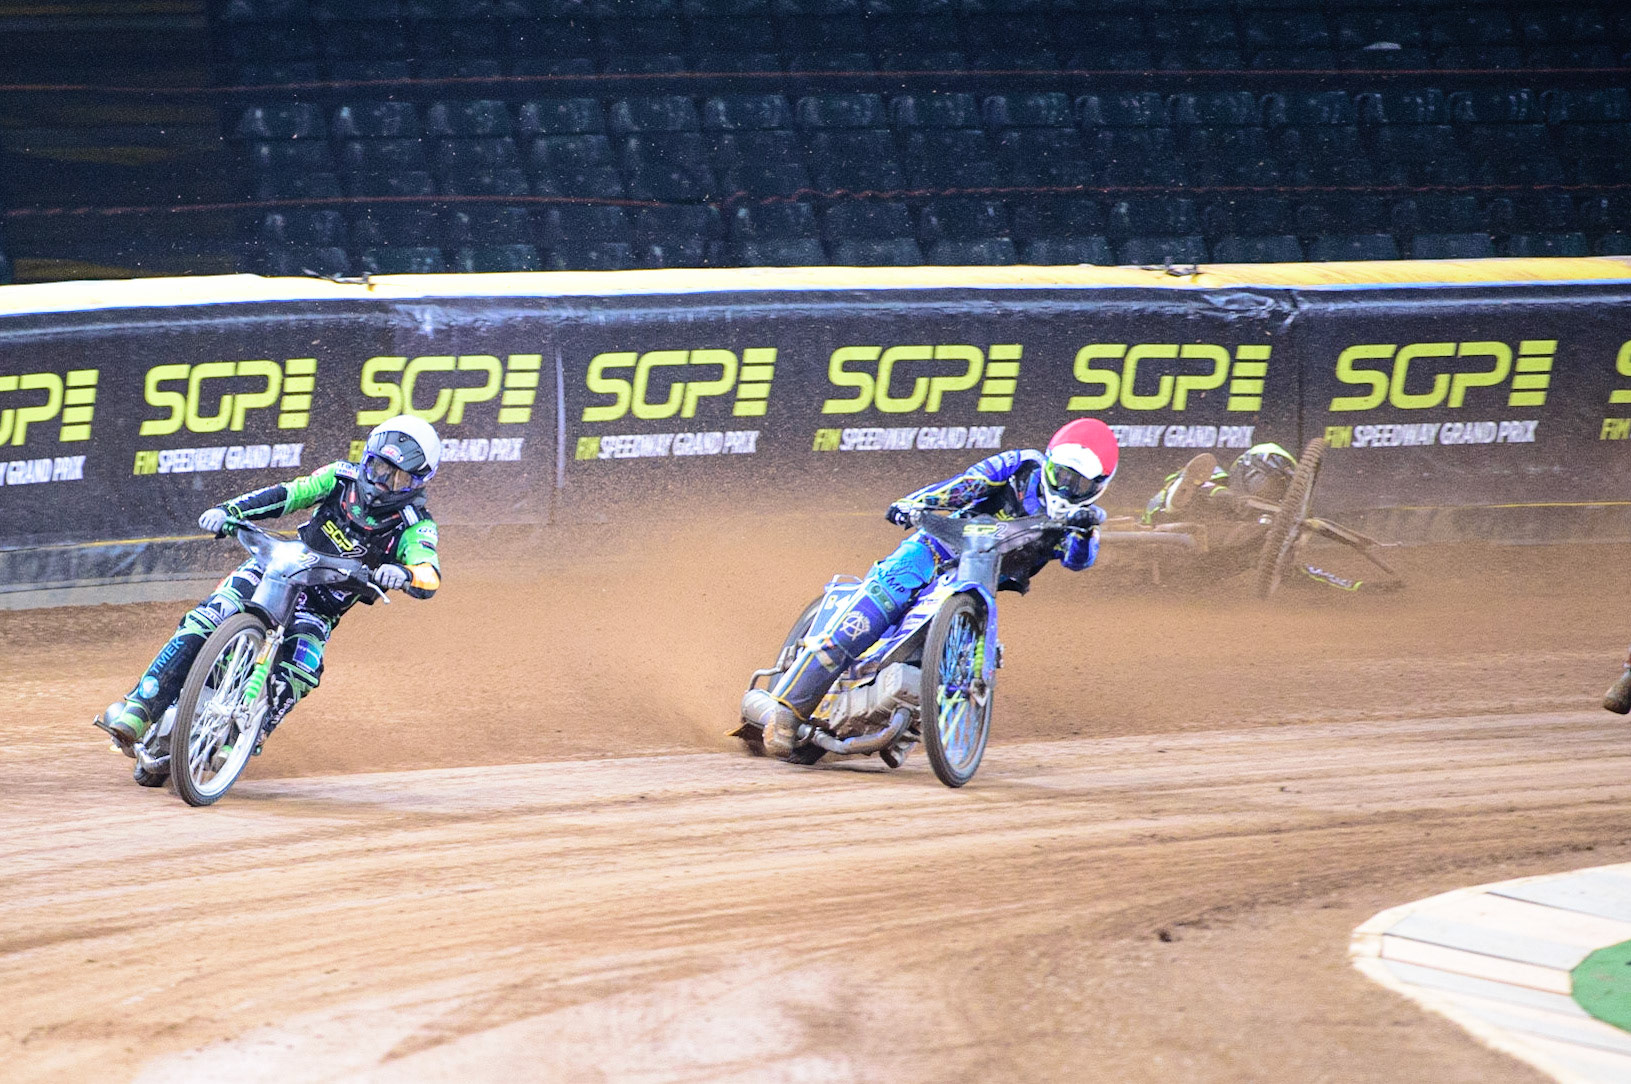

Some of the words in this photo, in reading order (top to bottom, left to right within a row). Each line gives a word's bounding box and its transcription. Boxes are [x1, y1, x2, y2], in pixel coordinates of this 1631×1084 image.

[139, 359, 284, 436] SGP
[356, 354, 503, 426] SGP
[581, 348, 739, 422] SGP
[821, 344, 985, 414] SGP
[1066, 343, 1231, 411] SGP
[1329, 342, 1513, 411] SGP
[225, 445, 272, 470] GRAND
[672, 431, 725, 456] GRAND
[839, 427, 920, 451] SPEEDWAY
[916, 426, 969, 450] GRAND
[966, 425, 1006, 449] PRIX
[1111, 425, 1167, 448] EDWAY
[1163, 425, 1218, 448] GRAND
[1217, 425, 1255, 448] PRIX
[1351, 422, 1442, 448] SPEEDWAY
[1439, 421, 1498, 445] GRAND
[1496, 420, 1539, 443] PRIX
[5, 458, 52, 486] GRAND
